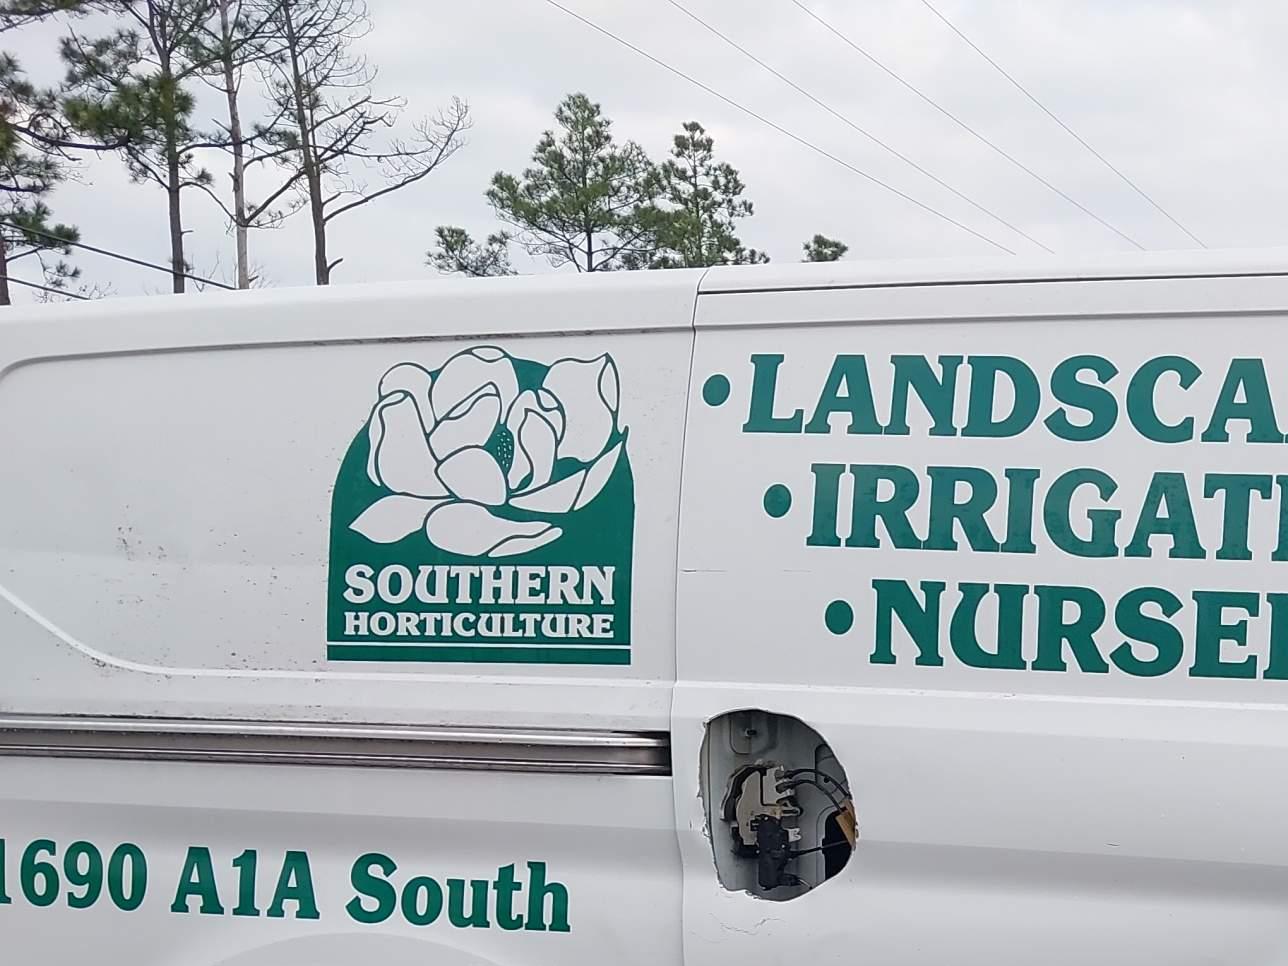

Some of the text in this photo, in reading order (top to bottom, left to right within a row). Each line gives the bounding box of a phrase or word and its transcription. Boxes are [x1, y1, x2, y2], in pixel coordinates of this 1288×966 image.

[343, 563, 616, 605] SOUTHERN
[343, 611, 615, 639] HORTICULTURE
[169, 845, 321, 921] A1A
[345, 852, 572, 933] South
